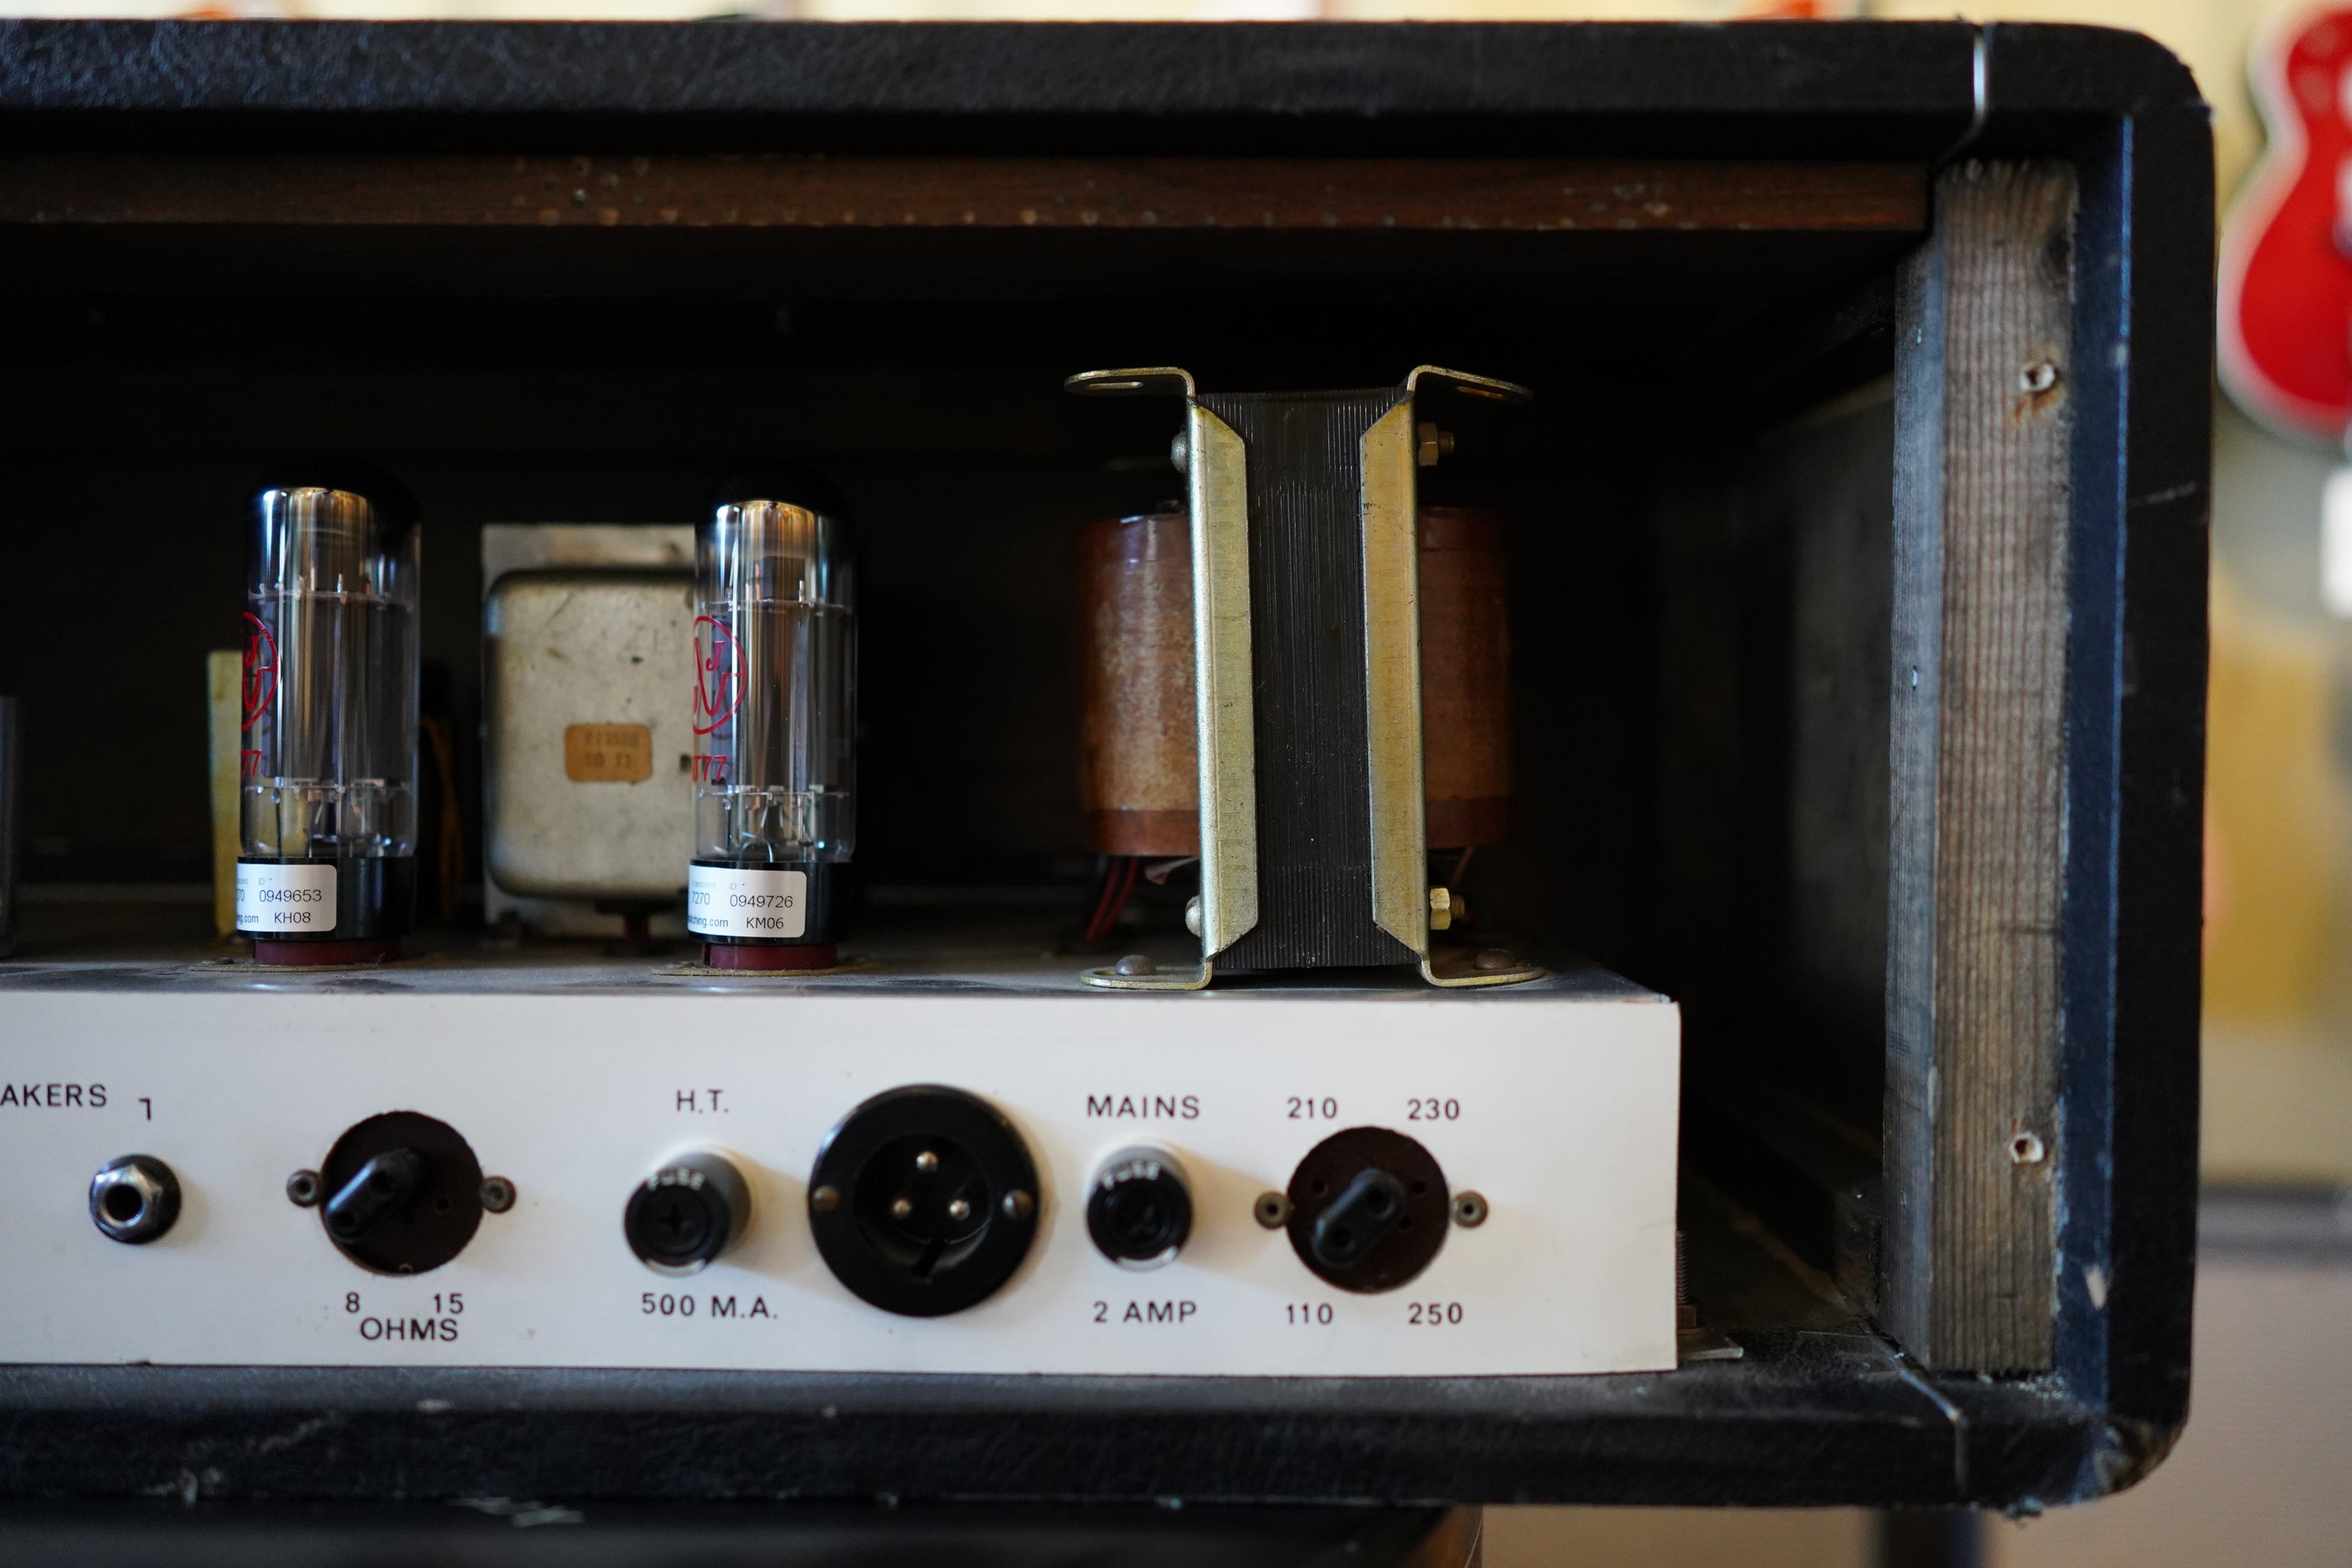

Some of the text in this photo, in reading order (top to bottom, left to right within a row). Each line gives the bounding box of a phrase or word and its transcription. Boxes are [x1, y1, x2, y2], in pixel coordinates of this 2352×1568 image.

[259, 889, 323, 903] 0949653
[730, 894, 793, 909] 0949726
[274, 911, 312, 924] KH08
[746, 917, 784, 929] KM06
[0, 1083, 106, 1108] AKERS
[676, 1089, 730, 1113] H.T.
[1087, 1095, 1199, 1119] MAINS
[1288, 1097, 1460, 1120] 210 230
[345, 1292, 464, 1315] 8 15
[642, 1292, 779, 1319] 500 M.A.
[1094, 1301, 1197, 1323] 2 AMP
[1288, 1302, 1462, 1325] 110 250
[360, 1317, 458, 1341] OHMS
